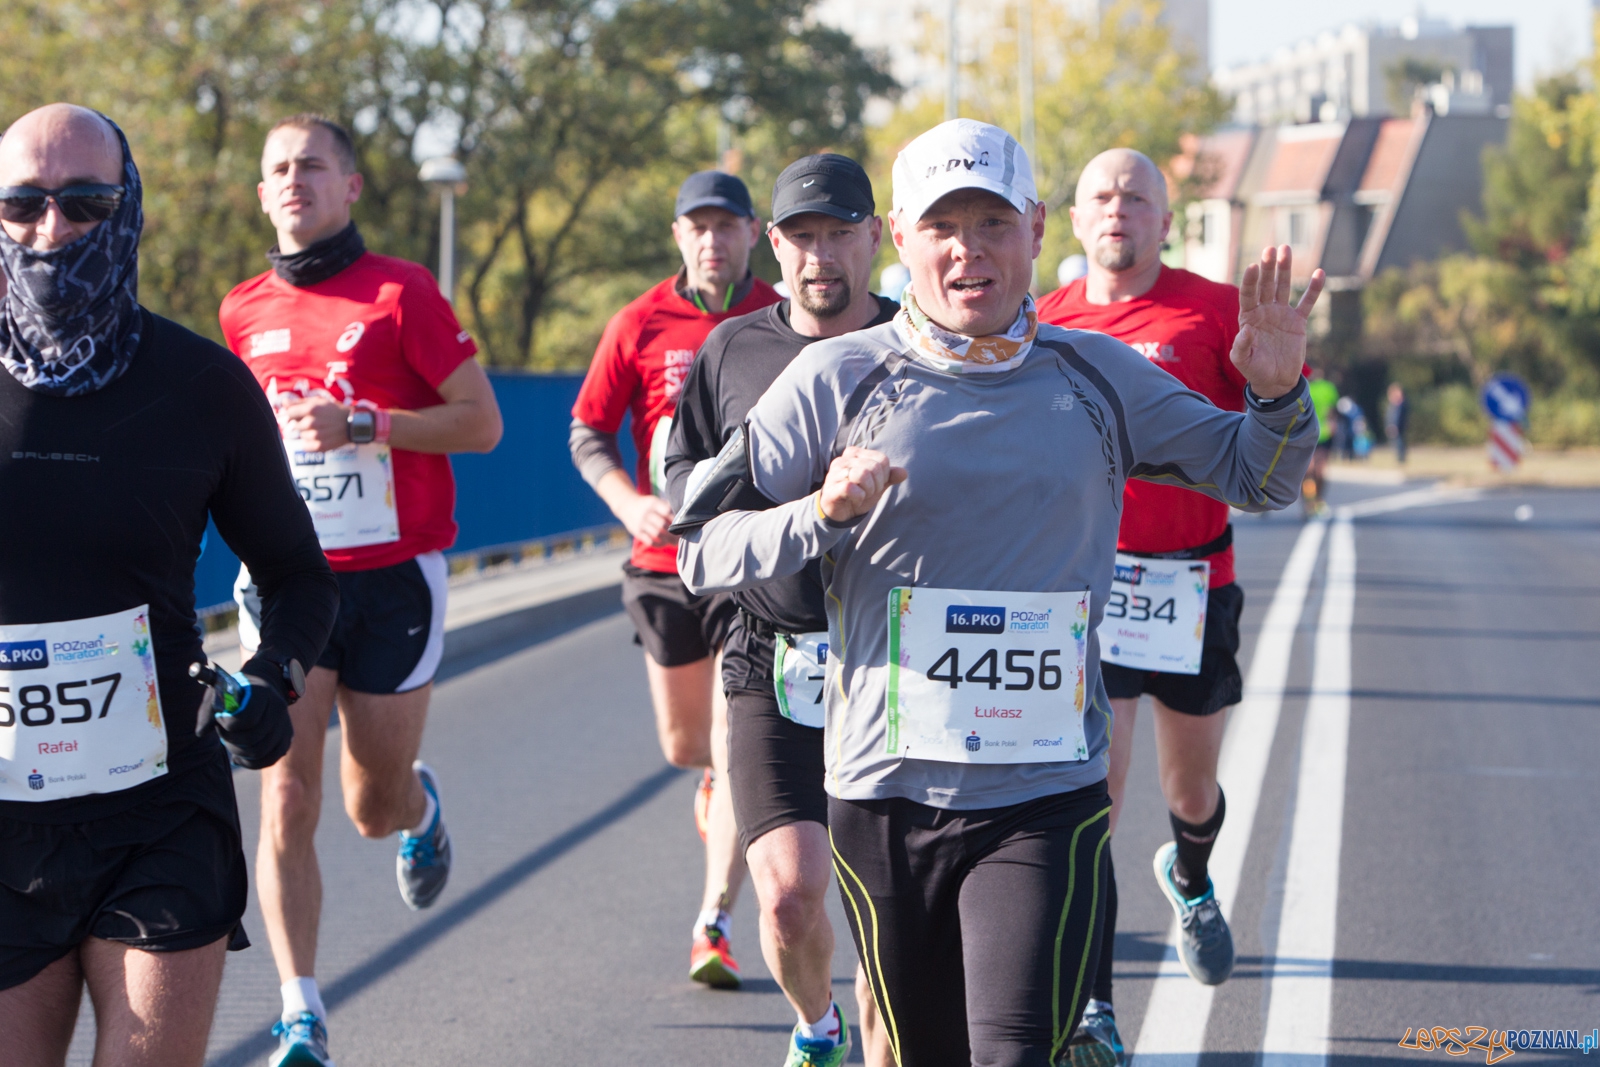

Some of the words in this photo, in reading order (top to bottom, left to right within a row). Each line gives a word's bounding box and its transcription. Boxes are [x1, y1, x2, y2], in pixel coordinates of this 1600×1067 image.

[951, 613, 969, 625] 16.
[971, 614, 1001, 626] PKO
[1010, 621, 1049, 630] maraton
[12, 648, 44, 662] PKO
[54, 648, 105, 661] maraton
[926, 647, 1062, 690] 4456
[974, 706, 1022, 719] Łukasz
[37, 740, 79, 755] Rafał
